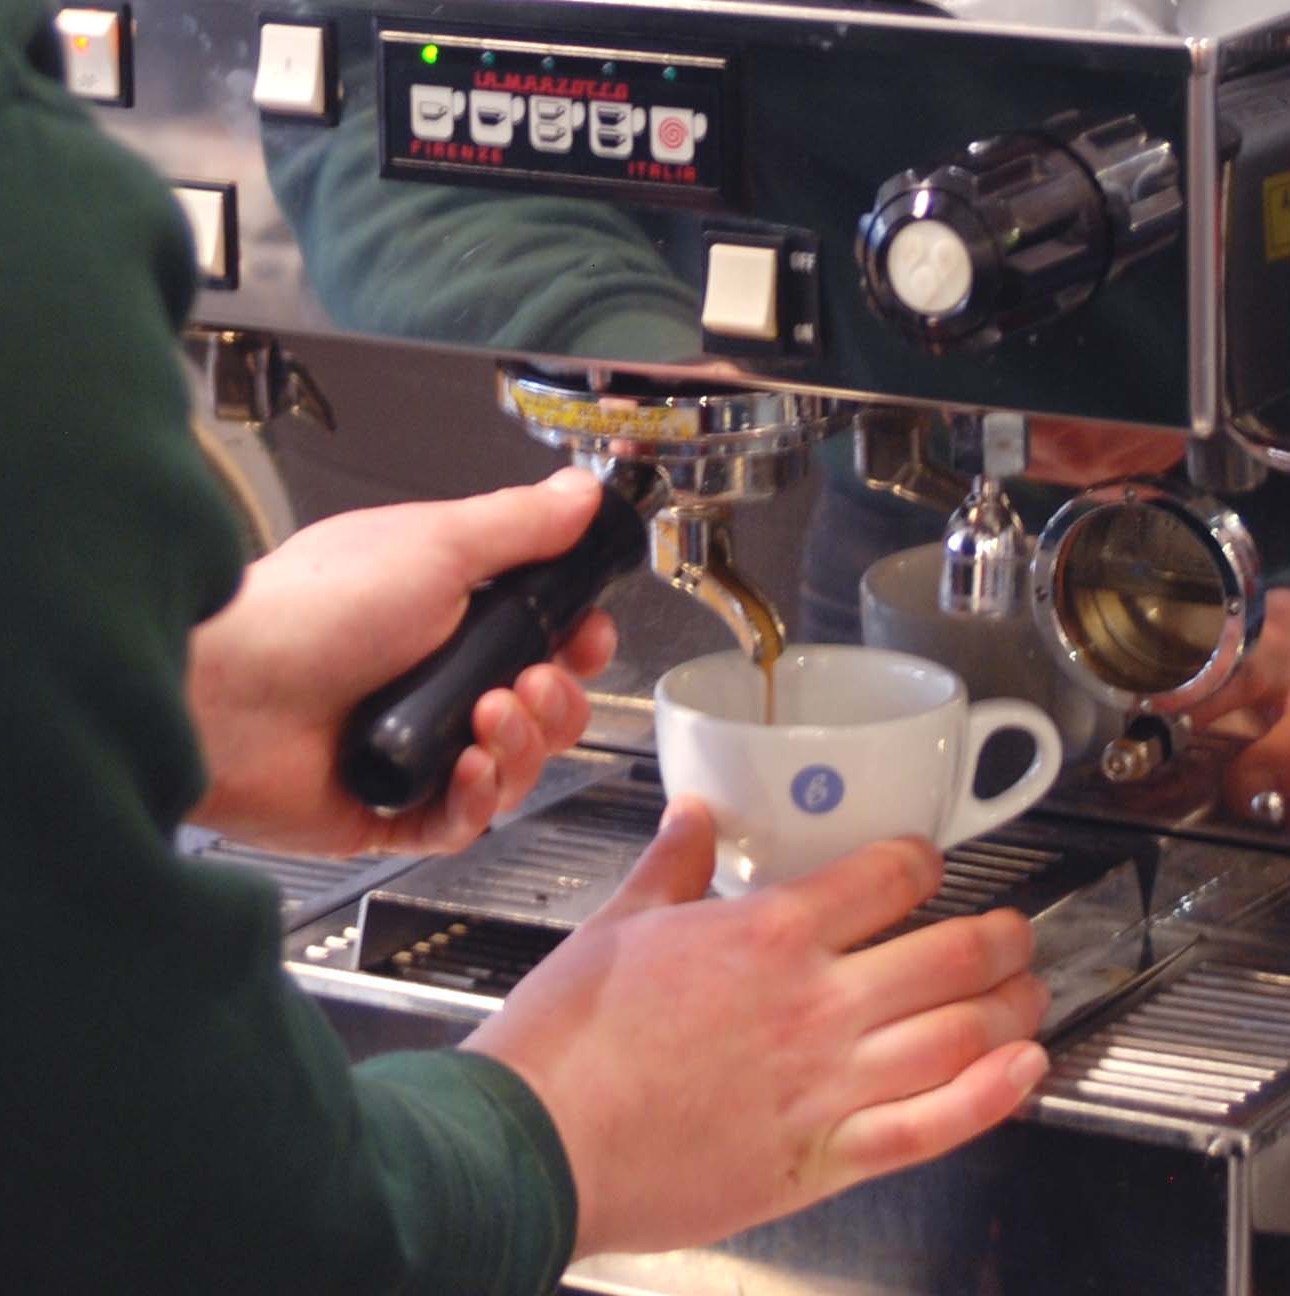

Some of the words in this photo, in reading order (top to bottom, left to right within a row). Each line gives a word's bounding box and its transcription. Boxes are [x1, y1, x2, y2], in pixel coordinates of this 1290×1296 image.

[409, 137, 503, 165] FIRENZE
[628, 159, 698, 185] ITALIA
[789, 250, 816, 274] OFF
